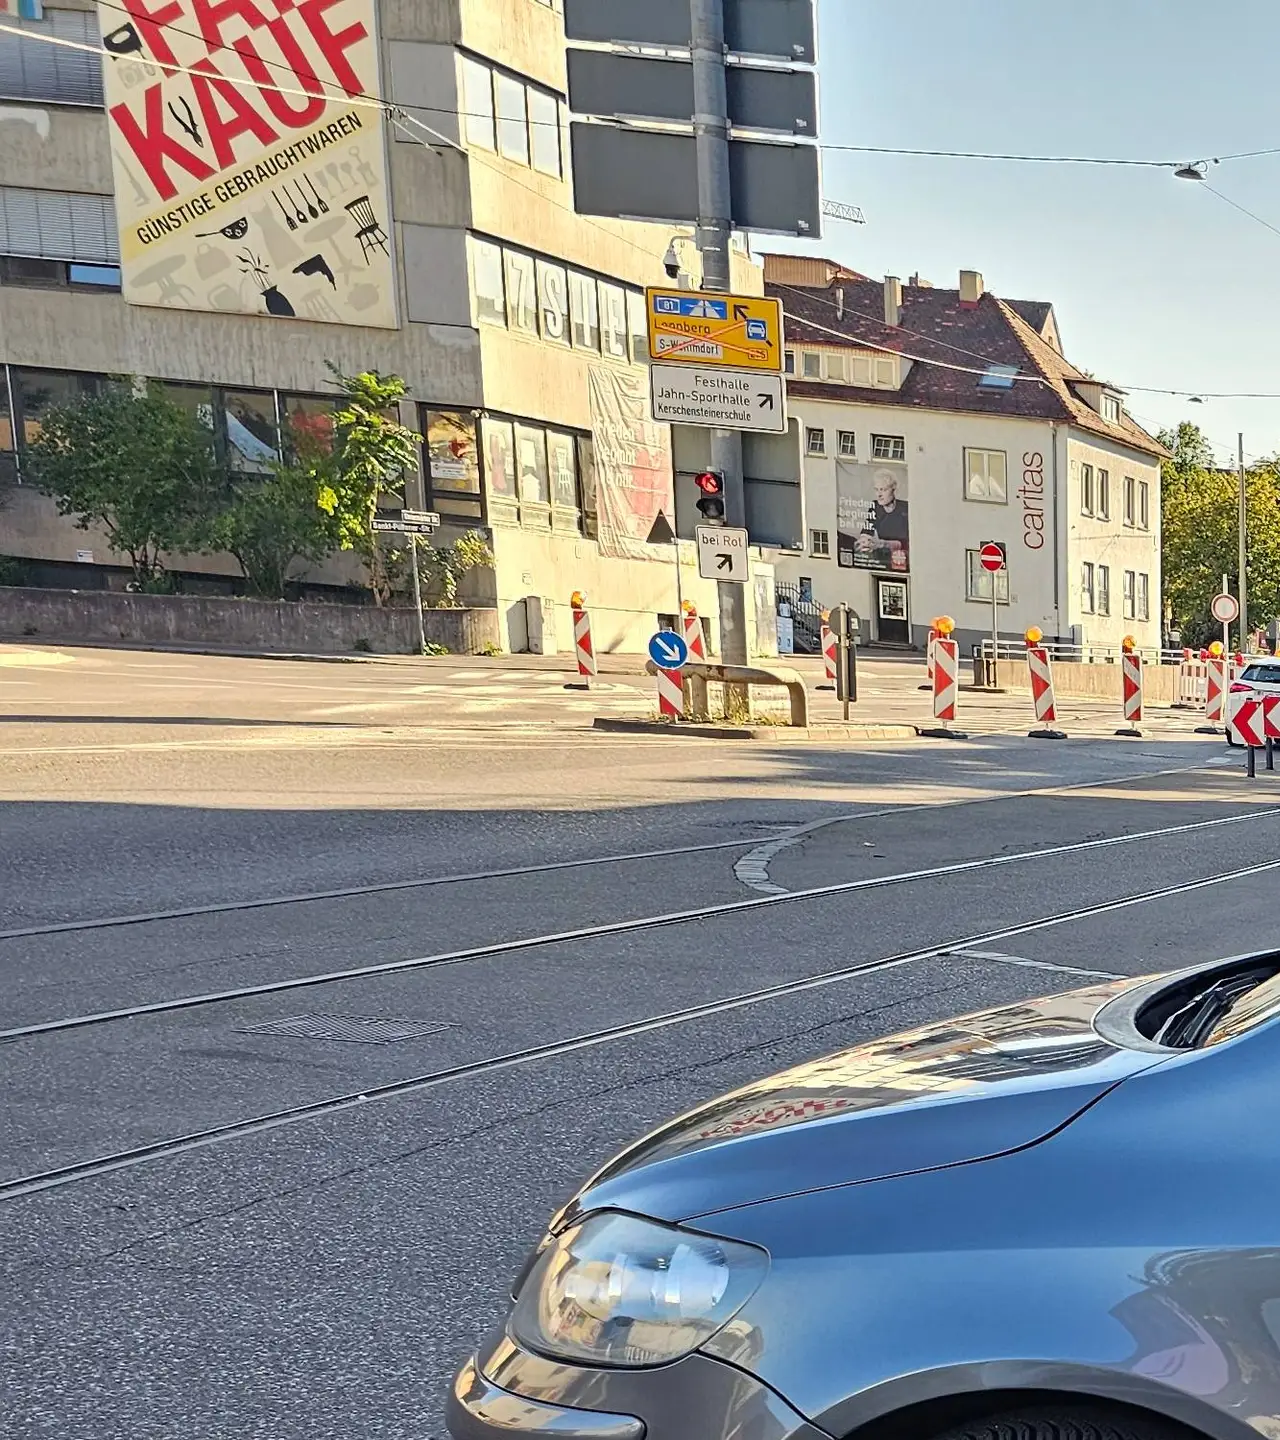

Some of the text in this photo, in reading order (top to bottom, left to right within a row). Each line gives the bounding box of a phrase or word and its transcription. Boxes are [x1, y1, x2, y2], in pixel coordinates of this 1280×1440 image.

[109, 0, 369, 202] KAUF
[137, 111, 363, 245] GÜNSTIGE GEBRAUCHTWAREN
[695, 376, 750, 391] Festhalle
[658, 388, 751, 406] Jahn-Sporthalle
[658, 403, 751, 421] Kerschensteinerschule
[839, 496, 876, 509] Frieden
[1016, 452, 1044, 549] caritas
[839, 506, 877, 520] beginnt
[839, 518, 875, 530] bei mir.
[702, 533, 742, 547] bei Rot
